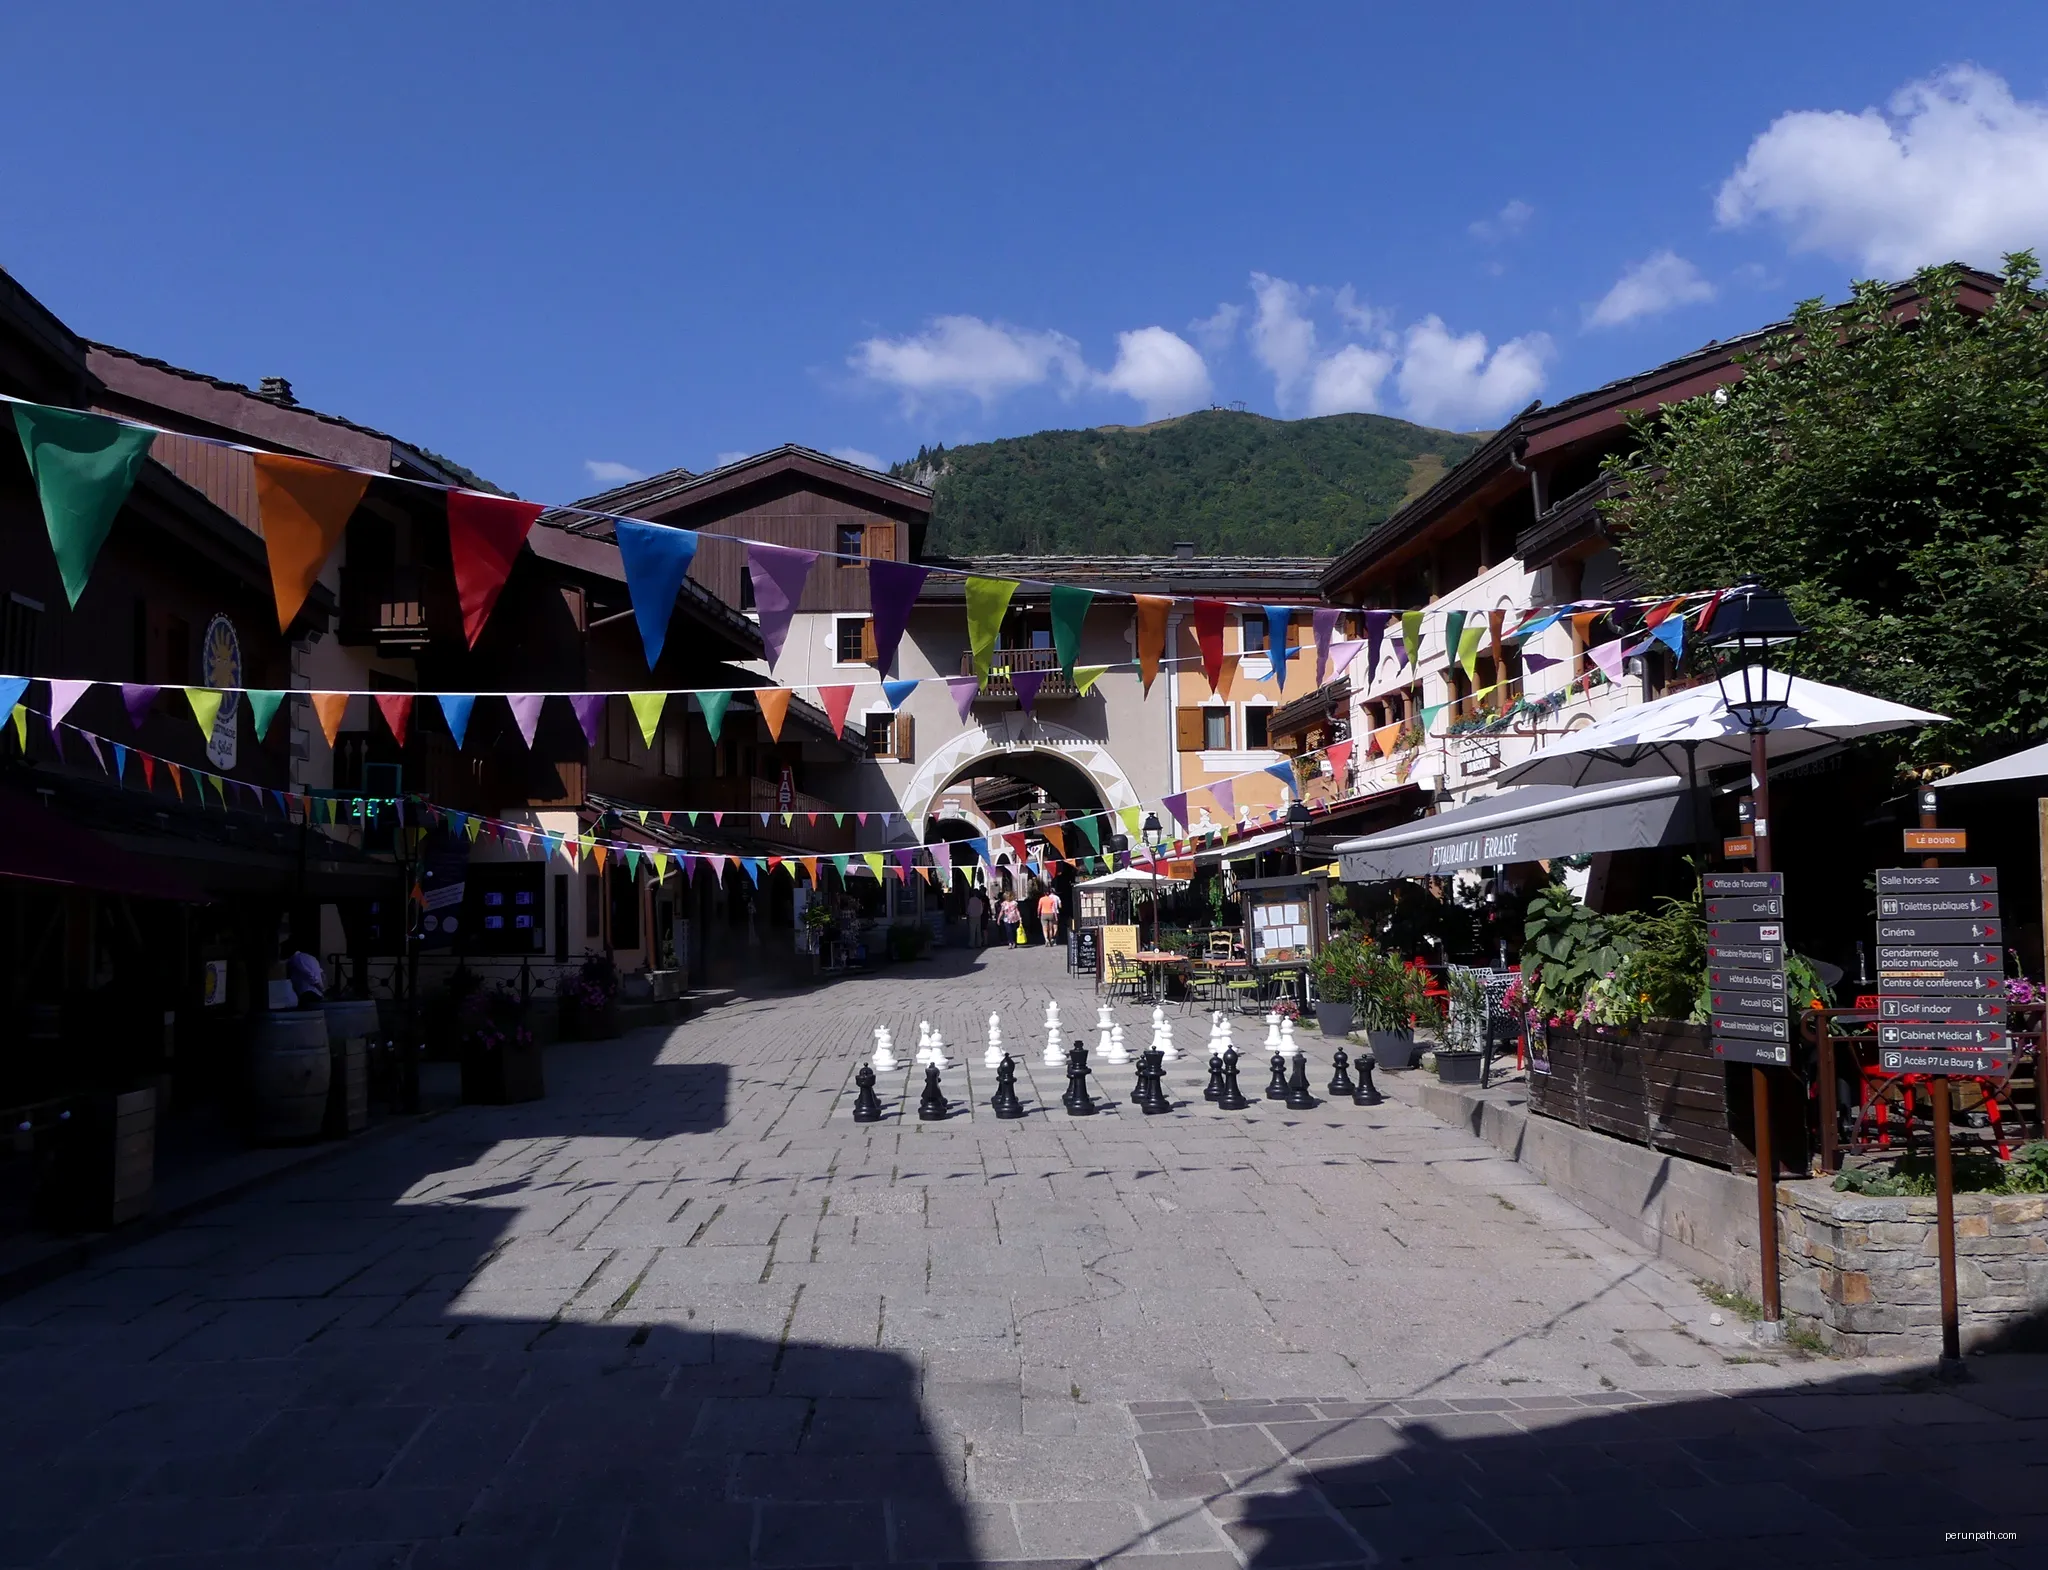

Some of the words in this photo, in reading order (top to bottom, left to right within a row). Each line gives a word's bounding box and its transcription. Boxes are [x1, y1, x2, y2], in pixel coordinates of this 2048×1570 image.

[1469, 840, 1478, 861] LA
[1713, 880, 1731, 888] Office
[1732, 880, 1740, 888] de
[1740, 879, 1768, 888] Tourisme
[1881, 876, 1902, 885] Salle
[1903, 875, 1940, 885] hors-sac
[1752, 903, 1767, 912] Cash
[1899, 902, 1932, 911] Toilettes
[1933, 901, 1969, 913] publiques
[1881, 927, 1915, 937] Cinéma
[1881, 948, 1939, 957] Gendarmerie
[1881, 959, 1908, 968] police
[1910, 959, 1959, 968] municipale
[1729, 975, 1744, 983] Hôtel
[1744, 976, 1753, 984] du
[1753, 976, 1771, 986] Bourg
[1882, 978, 1912, 987] Centre
[1914, 978, 1924, 987] de
[1925, 977, 1973, 987] conférence
[1740, 998, 1760, 1007] Accueil
[1901, 1003, 1920, 1013] Golf
[1921, 1004, 1951, 1013] indoor
[1720, 1020, 1737, 1029] Accueil
[1760, 1023, 1773, 1033] Soleil
[1900, 1030, 1935, 1040] Cabinet
[1937, 1031, 1972, 1040] Médical
[1755, 1048, 1775, 1059] Akoya
[1903, 1056, 1927, 1066] Accès
[1928, 1057, 1938, 1066] P7
[1939, 1057, 1949, 1066] Le
[1950, 1057, 1974, 1069] Bourg
